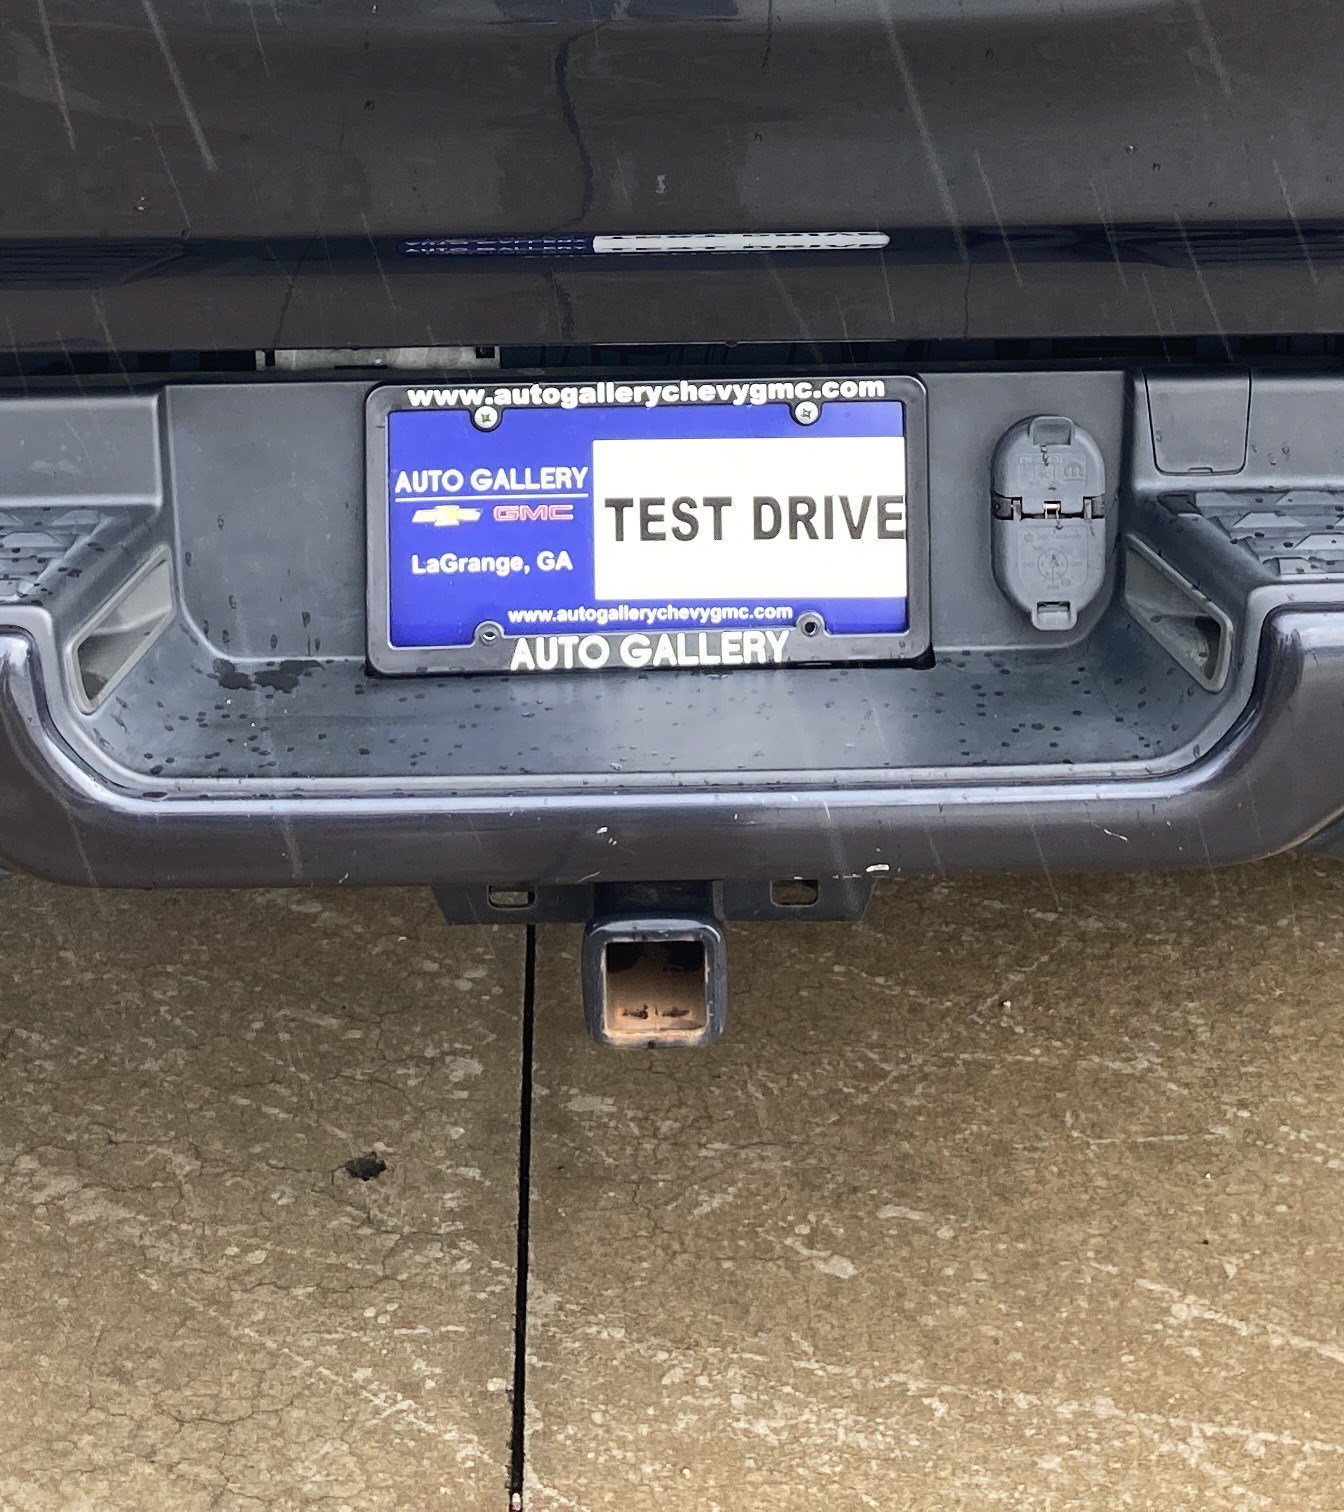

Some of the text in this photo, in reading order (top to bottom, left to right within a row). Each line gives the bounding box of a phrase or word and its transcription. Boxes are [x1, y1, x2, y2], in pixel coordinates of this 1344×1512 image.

[408, 379, 885, 408] www.autogallerychevygmc.com
[395, 466, 589, 493] AUTO GALLERY
[493, 504, 574, 522] GMC
[605, 494, 905, 541] TEST DRIVE
[411, 550, 574, 577] LaGrange, GA
[508, 604, 793, 625] www.autogallerychevygmc.com
[510, 630, 790, 670] AUTO GALLERY
